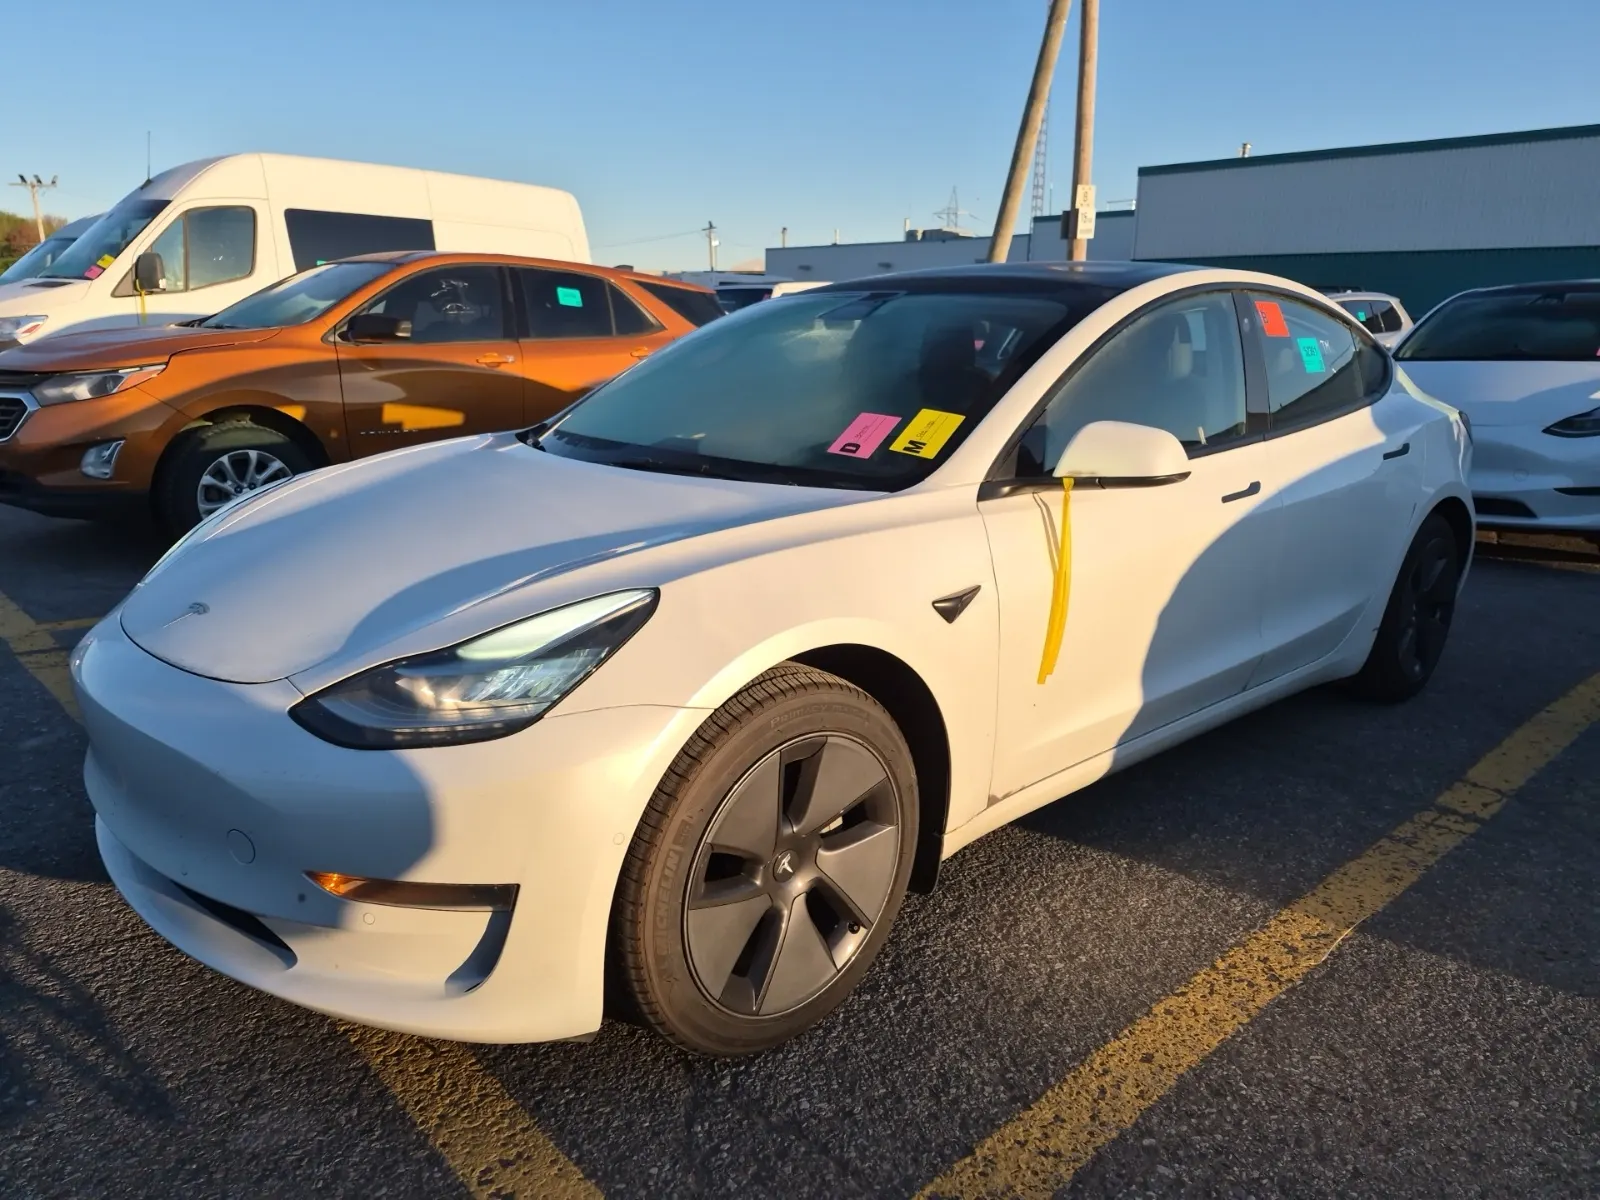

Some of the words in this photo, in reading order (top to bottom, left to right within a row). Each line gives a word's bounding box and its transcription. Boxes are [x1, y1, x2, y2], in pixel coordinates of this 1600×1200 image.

[839, 442, 861, 454] D
[902, 439, 927, 454] M
[655, 850, 682, 957] MICHELIN
